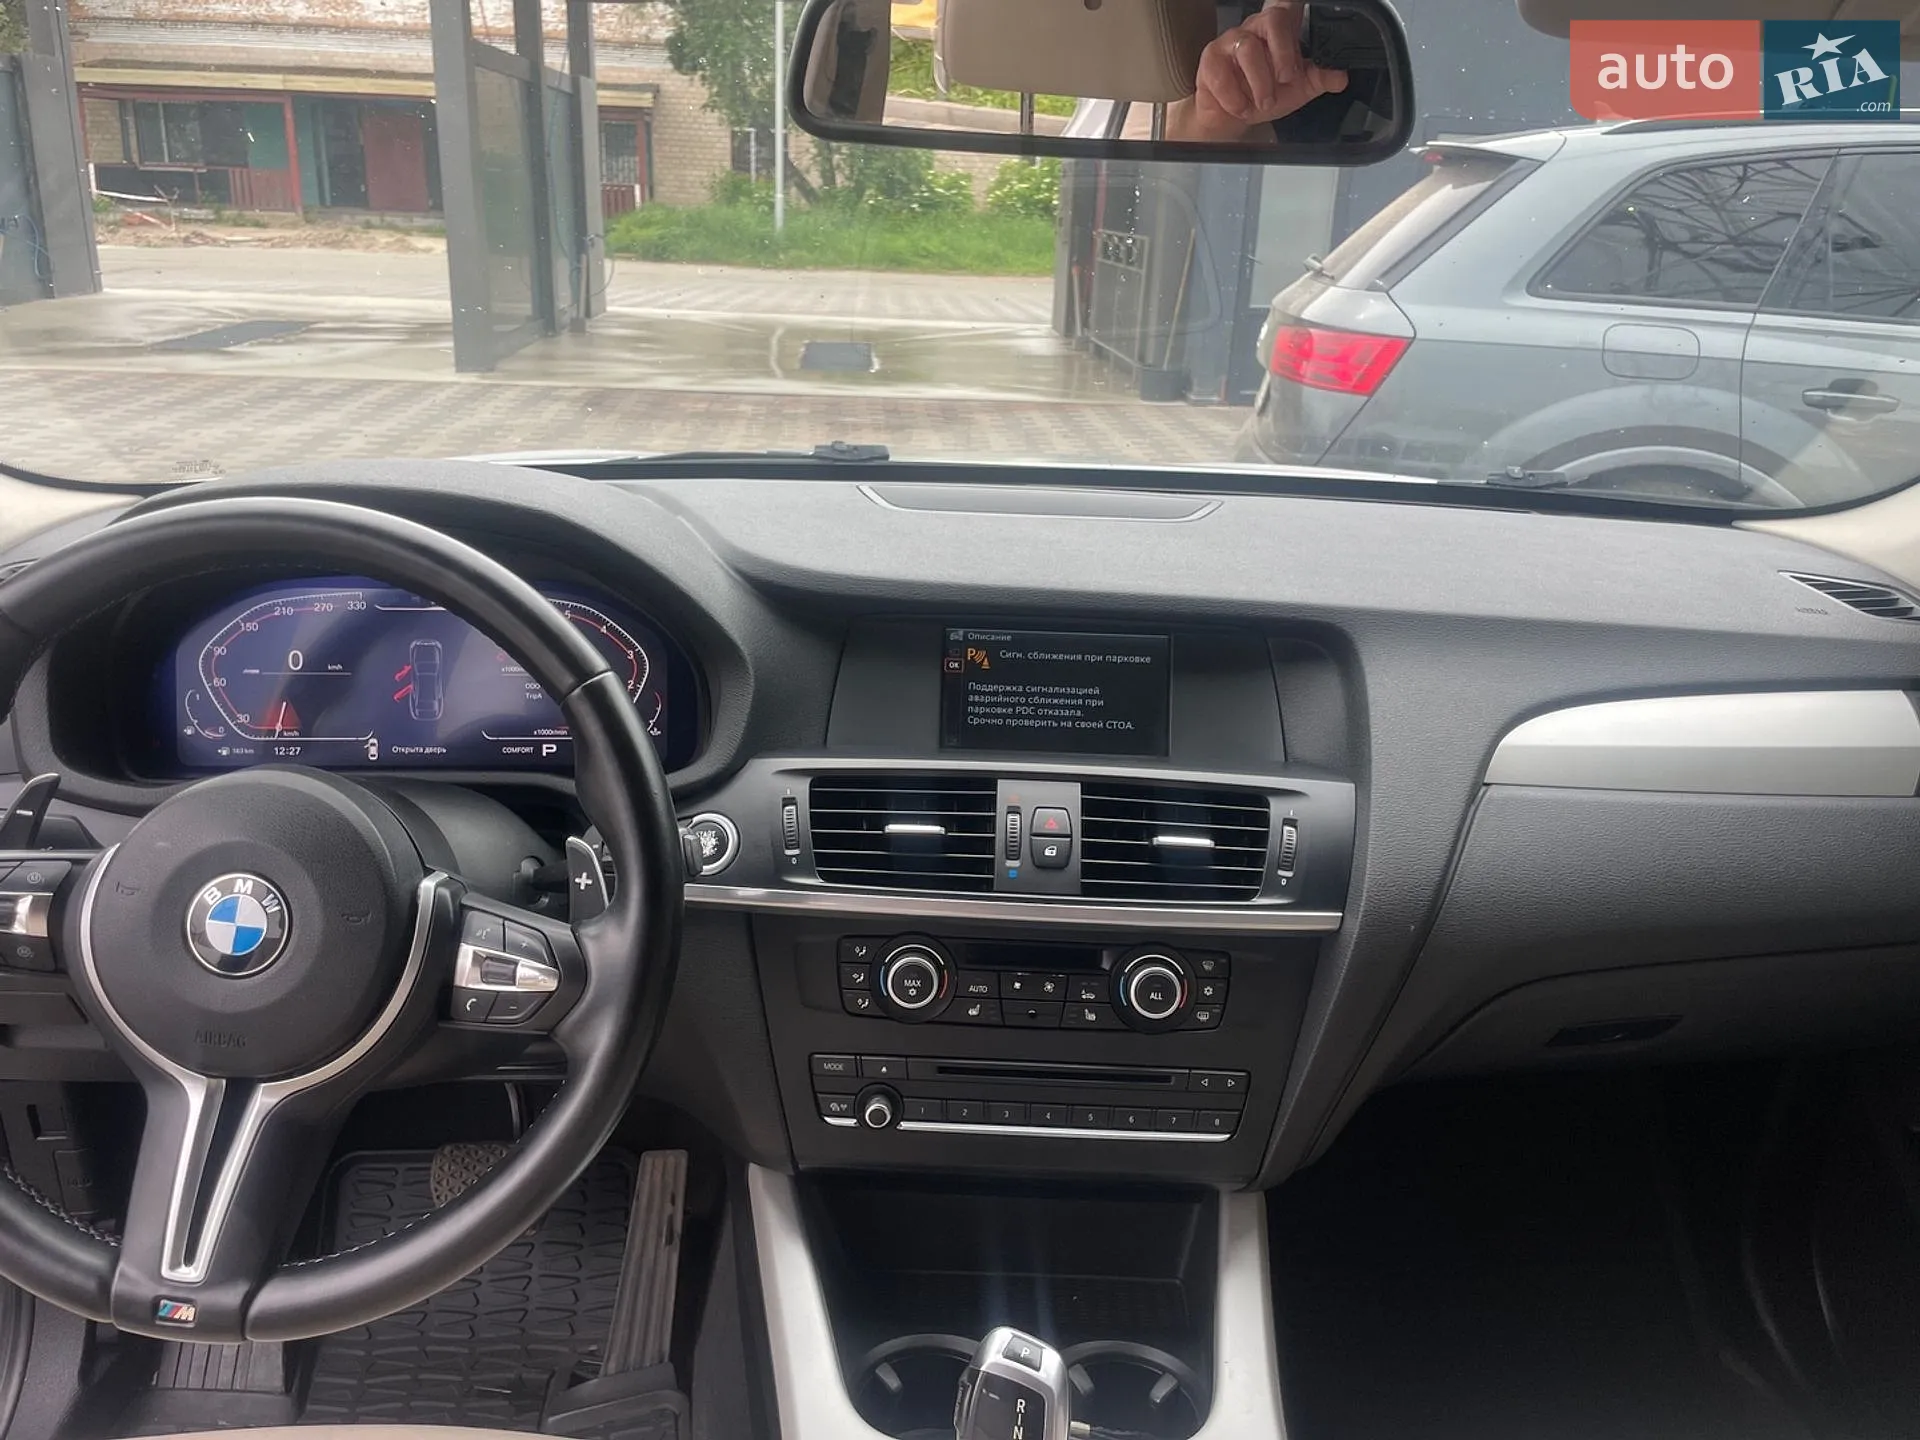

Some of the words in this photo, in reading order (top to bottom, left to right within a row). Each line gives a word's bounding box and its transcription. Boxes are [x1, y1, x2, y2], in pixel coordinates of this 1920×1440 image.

[274, 606, 294, 616] 210
[313, 603, 334, 612] 270
[347, 601, 367, 611] 330
[240, 622, 259, 632] 150
[600, 625, 607, 634] 4
[967, 632, 1013, 641] Описание
[213, 646, 227, 656] 90
[627, 651, 634, 660] 3
[288, 650, 303, 671] 0
[999, 649, 1025, 660] Сигн.
[1027, 650, 1082, 662] сближения
[1084, 653, 1103, 663] при
[1105, 654, 1151, 664] парковке
[213, 677, 227, 687] 60
[968, 682, 1023, 693] Поддержка
[1025, 684, 1100, 695] сигнализацией
[968, 694, 1026, 704] аварийного
[1028, 696, 1083, 706] сближения
[1085, 698, 1104, 707] при
[968, 706, 1013, 715] парковке
[1015, 706, 1035, 715] PDC
[1037, 707, 1084, 717] отказала.
[236, 713, 250, 723] 30
[968, 715, 1003, 725] Срочно
[1005, 718, 1058, 728] проверить
[1074, 720, 1103, 729] своей
[273, 746, 302, 756] 12:27
[391, 745, 423, 755] Открыта
[424, 746, 447, 755] дверь
[502, 746, 535, 754] COMFORT
[541, 743, 557, 757] P
[203, 878, 282, 914] BMW
[904, 979, 921, 987] MAX
[968, 985, 988, 993] AUTO
[1149, 992, 1163, 1000] ALL
[1020, 1347, 1030, 1358] P
[1016, 1399, 1026, 1413] R
[1013, 1425, 1023, 1440] N
